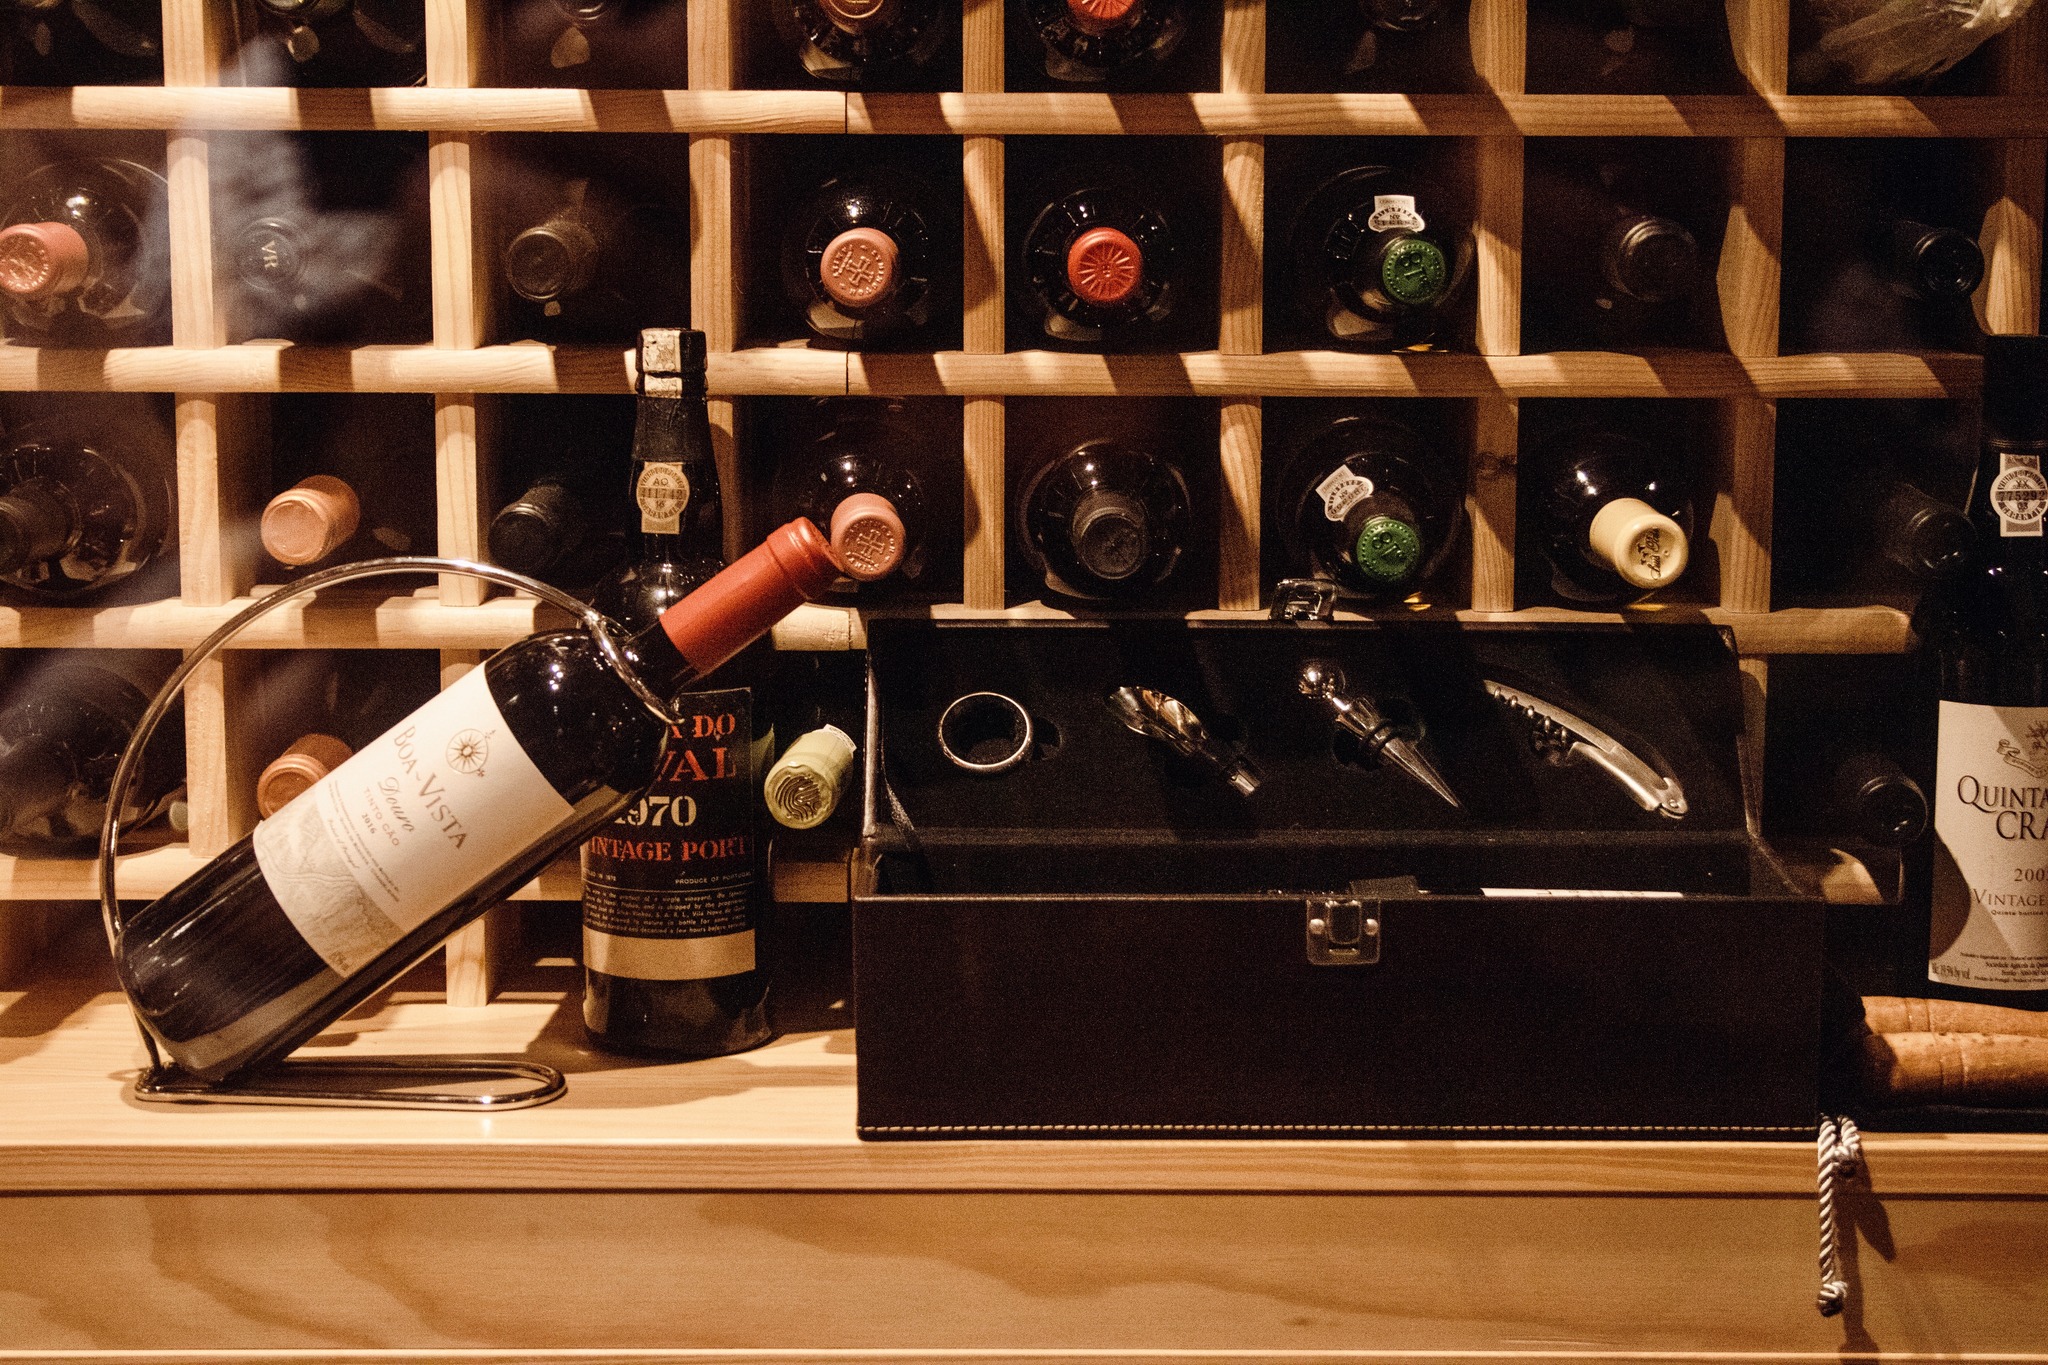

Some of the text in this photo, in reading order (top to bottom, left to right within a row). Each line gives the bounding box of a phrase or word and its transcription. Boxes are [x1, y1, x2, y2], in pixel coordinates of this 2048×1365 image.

[692, 713, 736, 738] DO
[363, 786, 383, 820] TINTO
[377, 776, 415, 833] Douro
[614, 795, 698, 827] 970
[361, 812, 378, 835] 2016
[675, 877, 708, 885] PRODUCE
[2013, 867, 2048, 882] 200
[1973, 887, 2047, 906] VINTAGE
